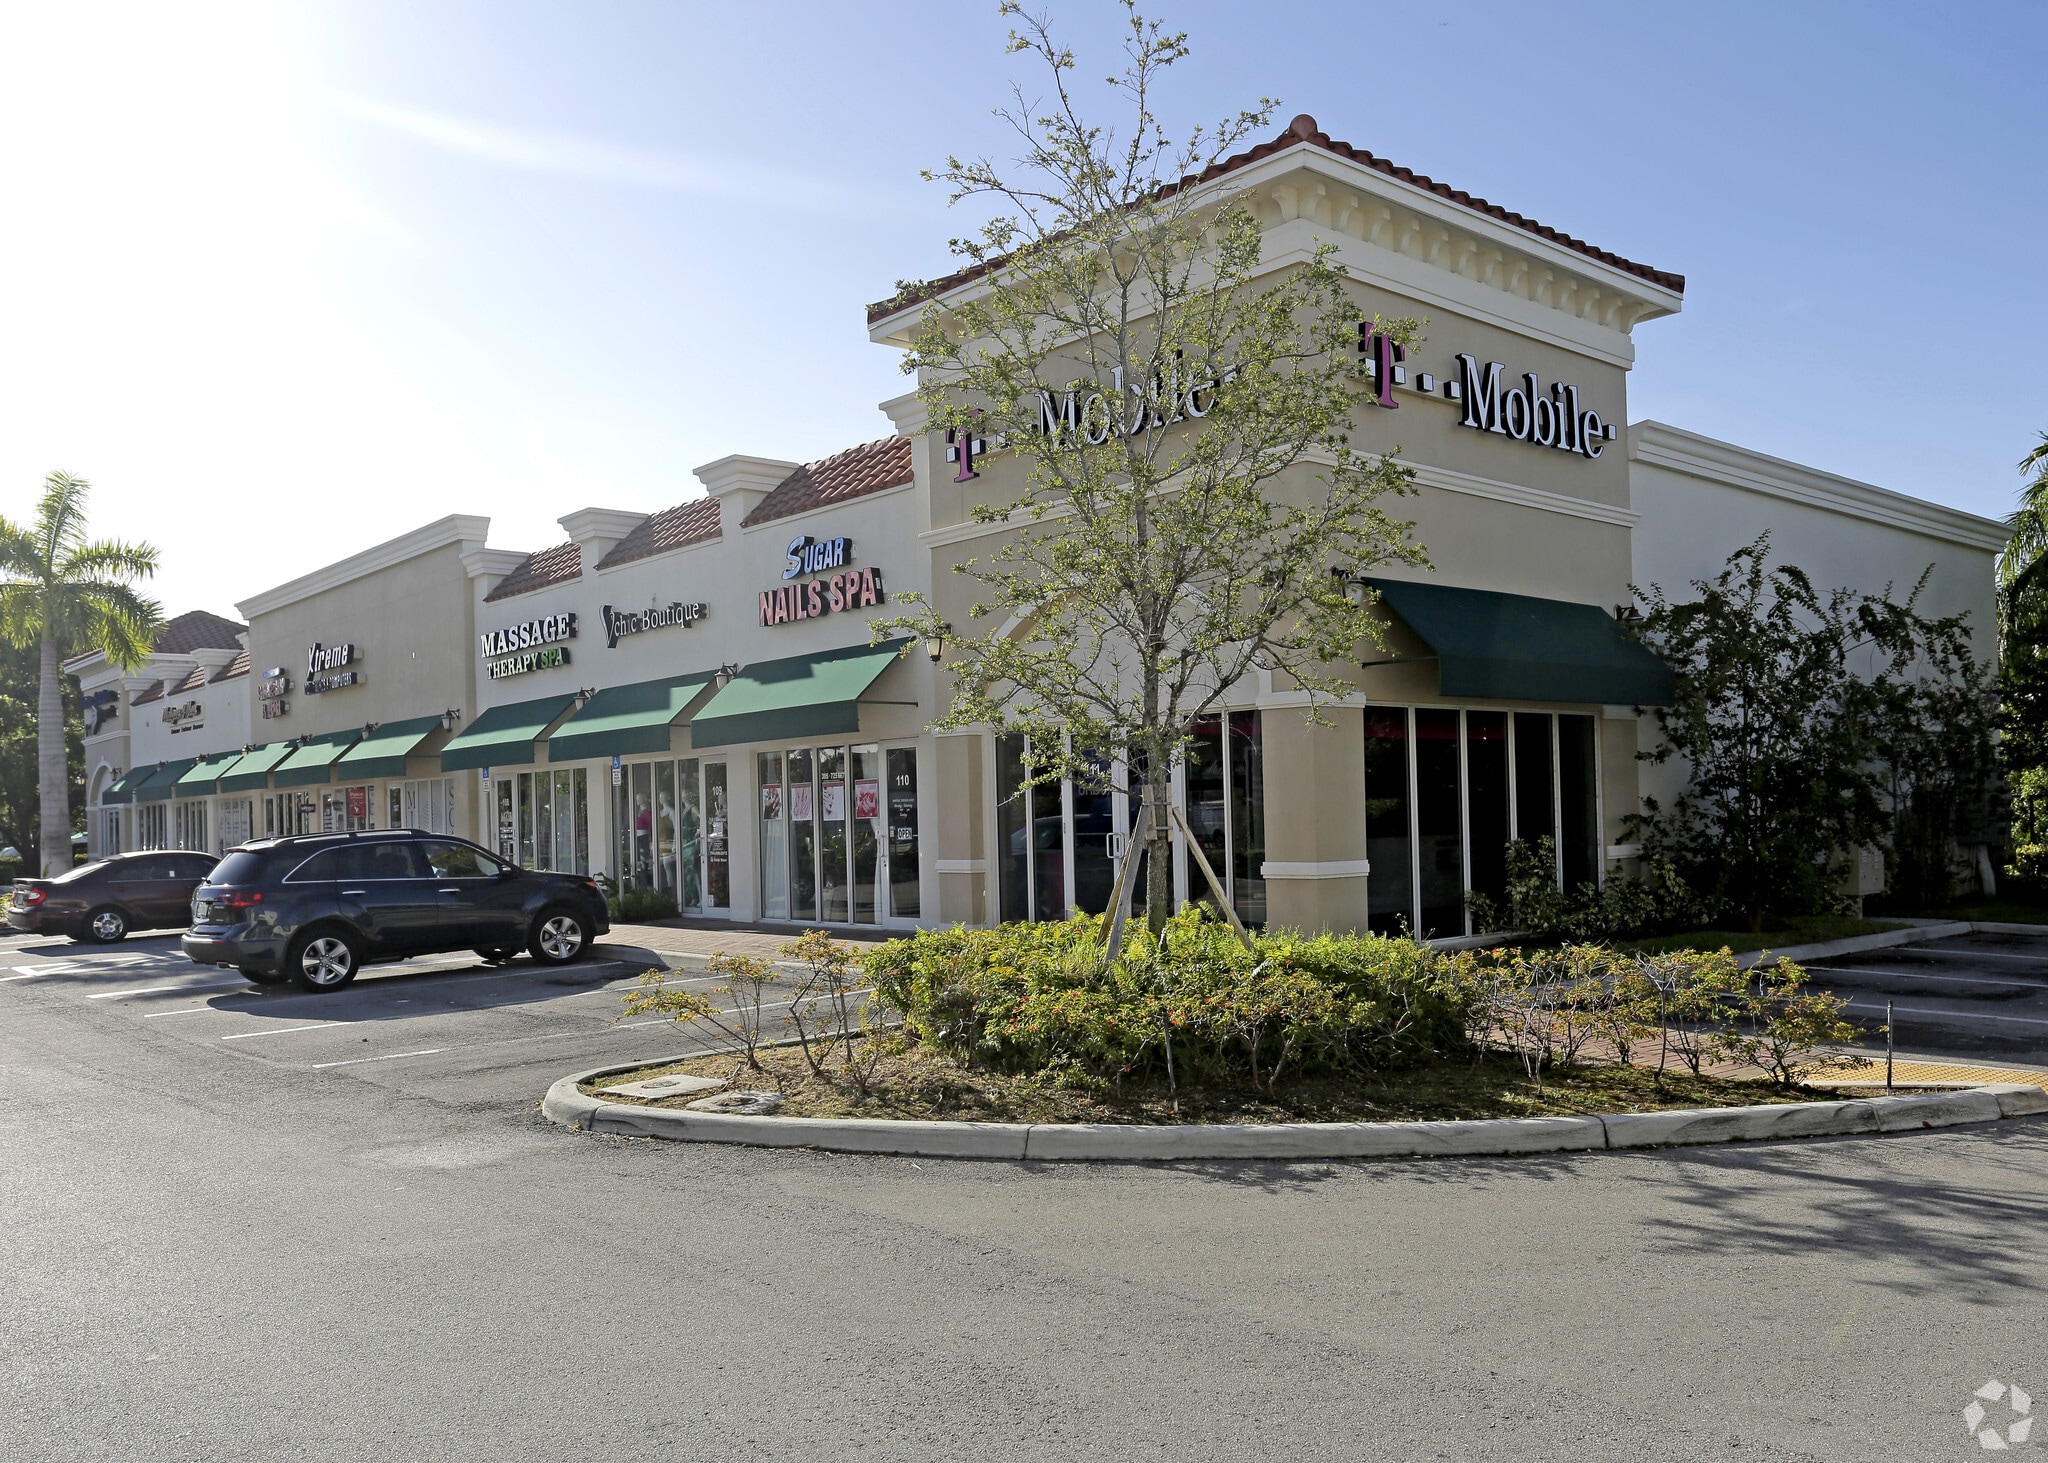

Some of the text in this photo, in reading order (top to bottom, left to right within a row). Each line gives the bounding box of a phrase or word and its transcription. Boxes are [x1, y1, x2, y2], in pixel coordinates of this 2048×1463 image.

[781, 535, 852, 580] SUGAR
[759, 567, 884, 627] NAILS SPA
[641, 602, 707, 630] Boutique
[480, 612, 576, 658] MASSAGE
[306, 642, 354, 681] Xtreme
[486, 646, 570, 680] THERAPY SPA
[712, 785, 723, 796] 109
[896, 774, 910, 786] 110
